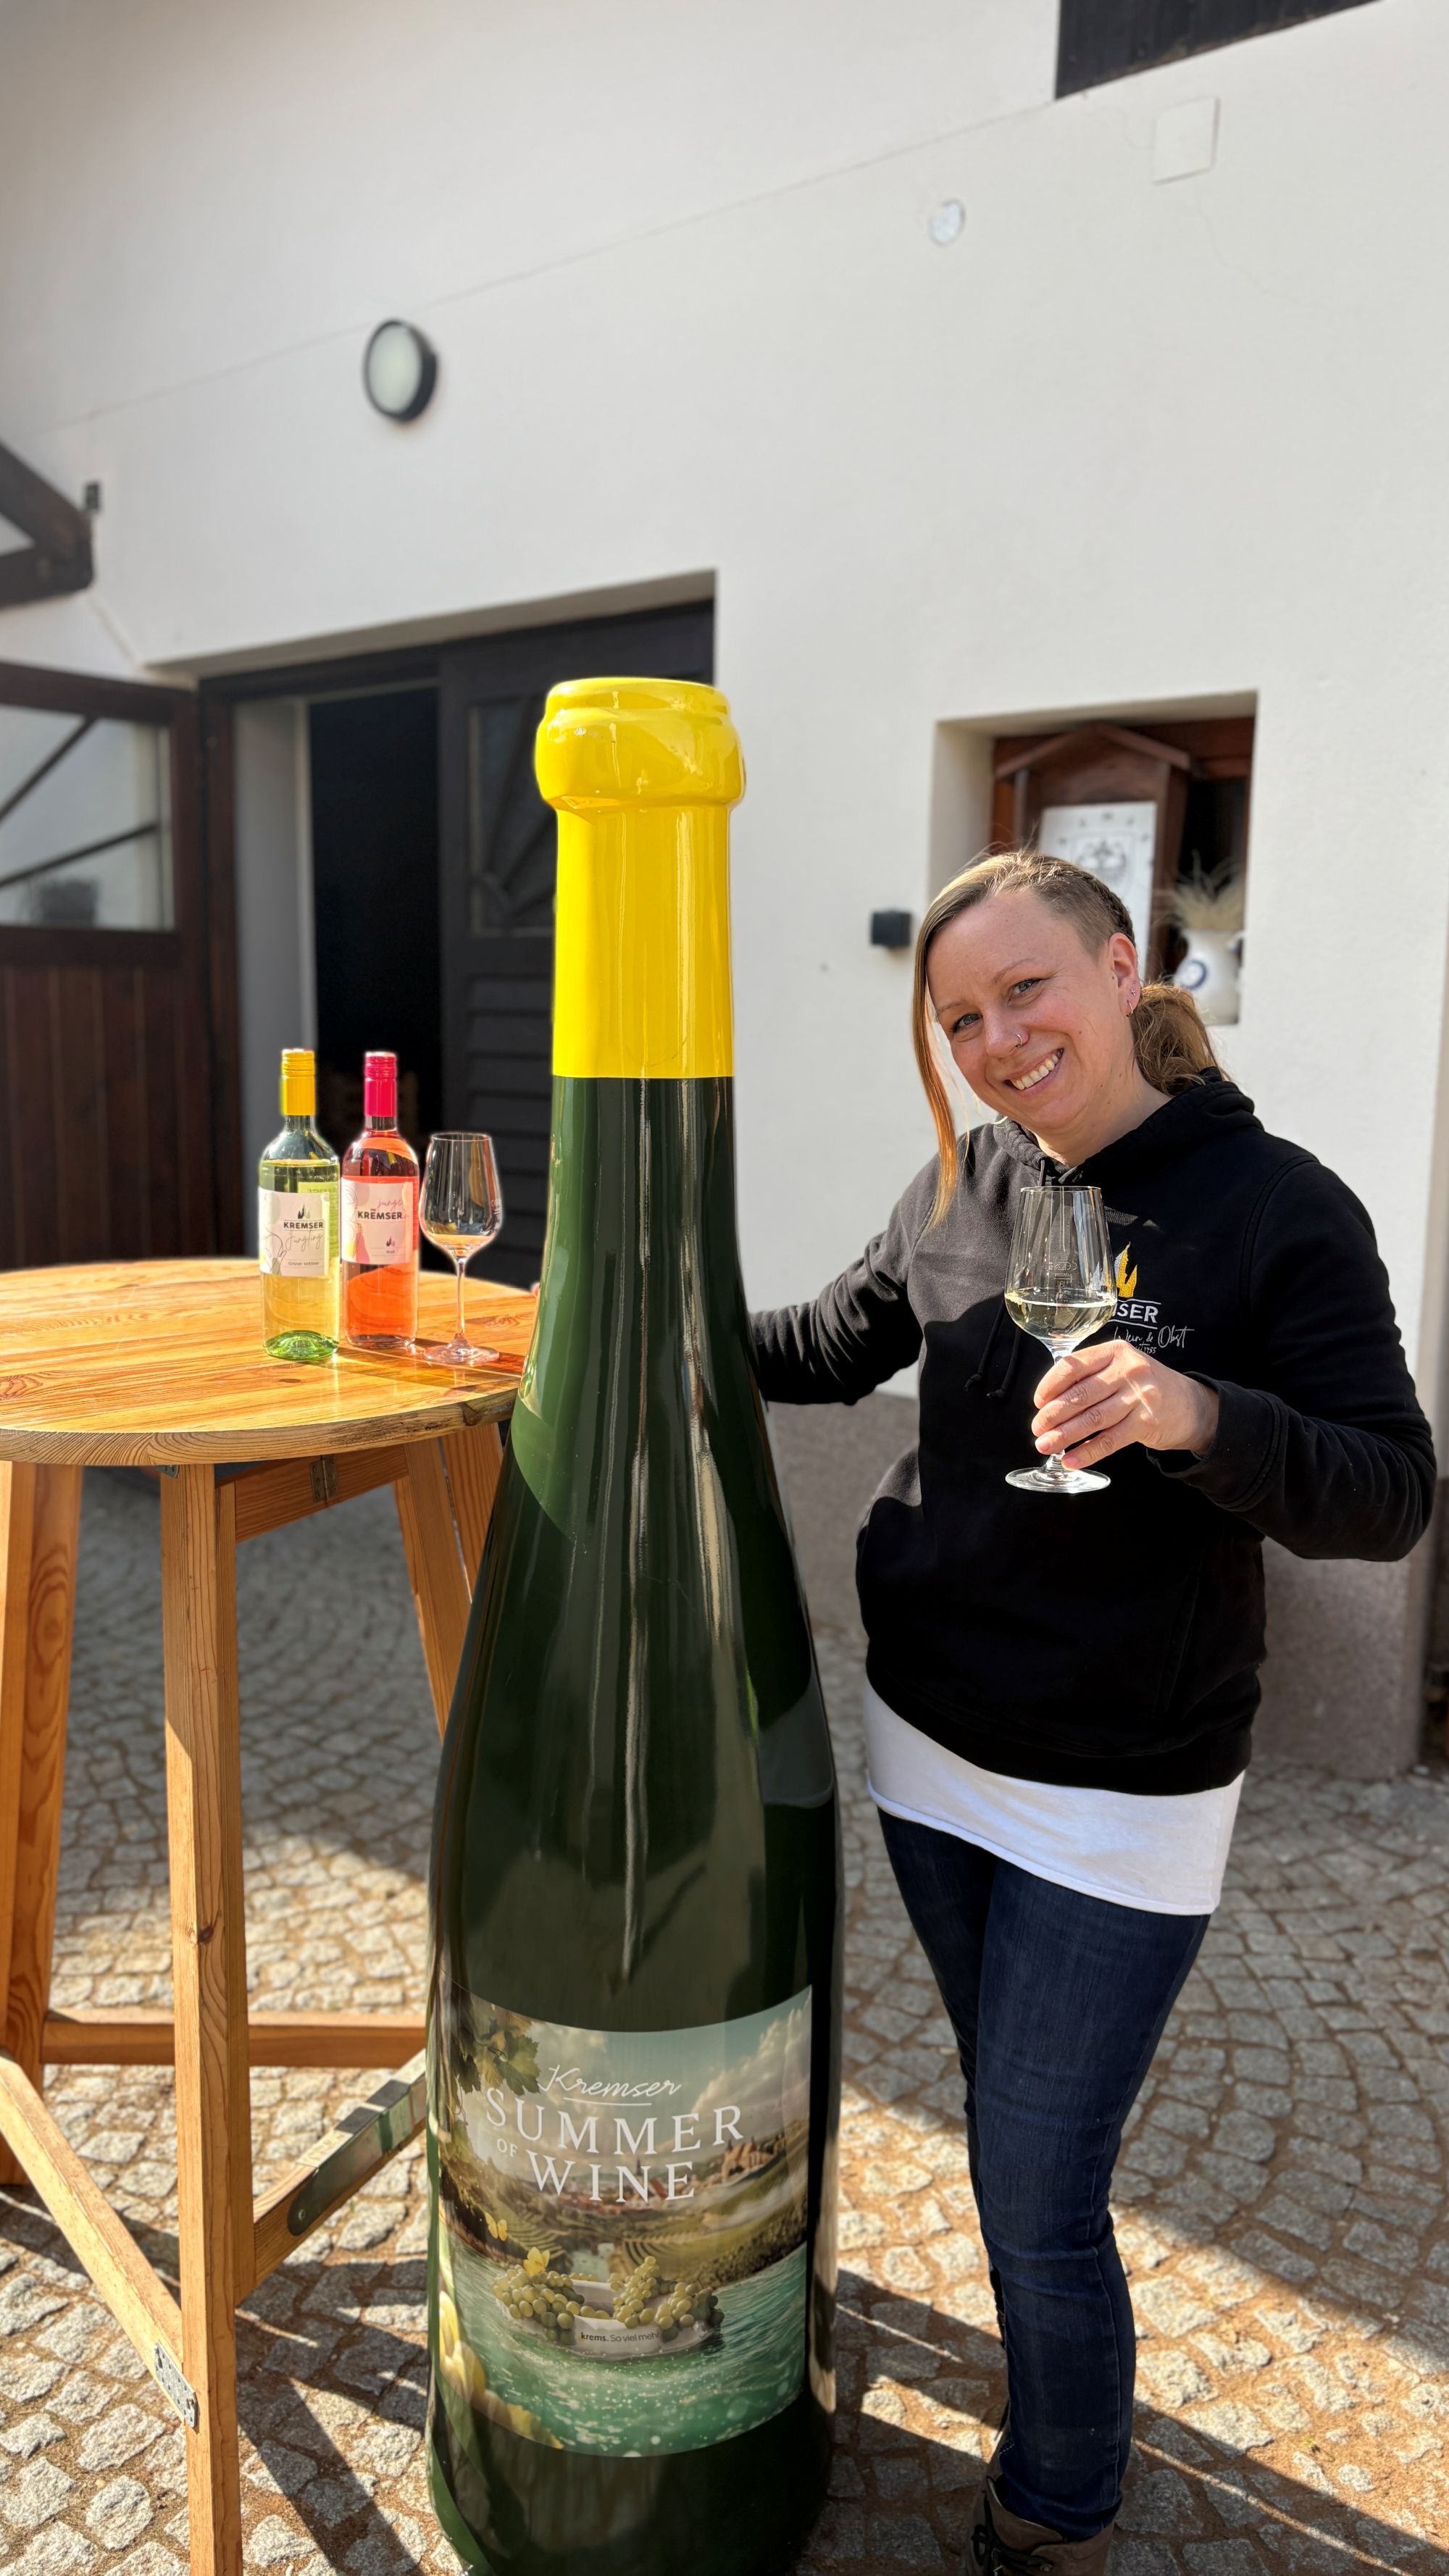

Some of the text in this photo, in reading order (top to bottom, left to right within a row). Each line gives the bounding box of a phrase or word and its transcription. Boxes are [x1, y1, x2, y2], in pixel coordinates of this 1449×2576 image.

[357, 1211, 403, 1220] KREMSER
[538, 2065, 682, 2099] Kremser
[485, 2086, 744, 2155] SUMMER
[496, 2138, 519, 2158] OF
[525, 2148, 695, 2203] WINE
[580, 2332, 610, 2342] krems.
[622, 2333, 638, 2342] viel
